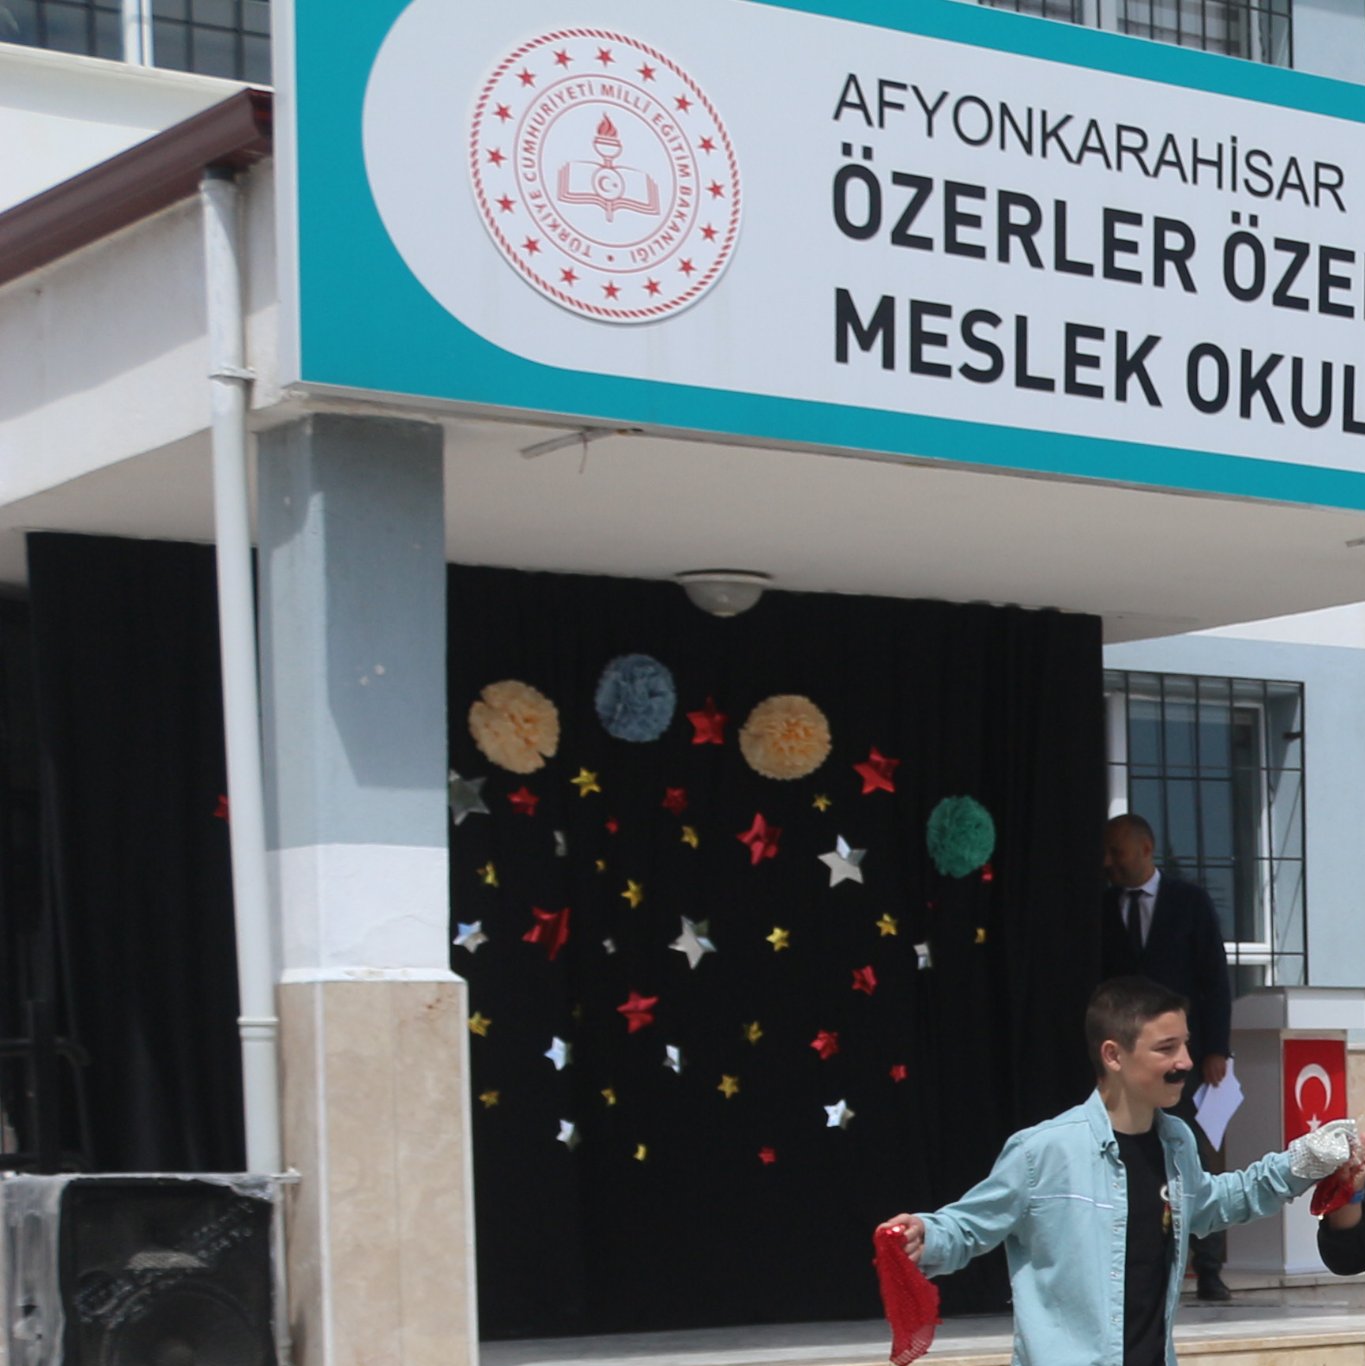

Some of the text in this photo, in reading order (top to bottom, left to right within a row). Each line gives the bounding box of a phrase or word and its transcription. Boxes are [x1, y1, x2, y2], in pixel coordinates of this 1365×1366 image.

[522, 80, 693, 264] TÜRKİYE CUMHURİYETİ MİLLİ EĞİTİM BAKANLIĞI
[832, 73, 1347, 212] AFYONKARAHİSAR
[832, 141, 1198, 294] ÖZERLER
[834, 287, 1163, 408] MESLEK
